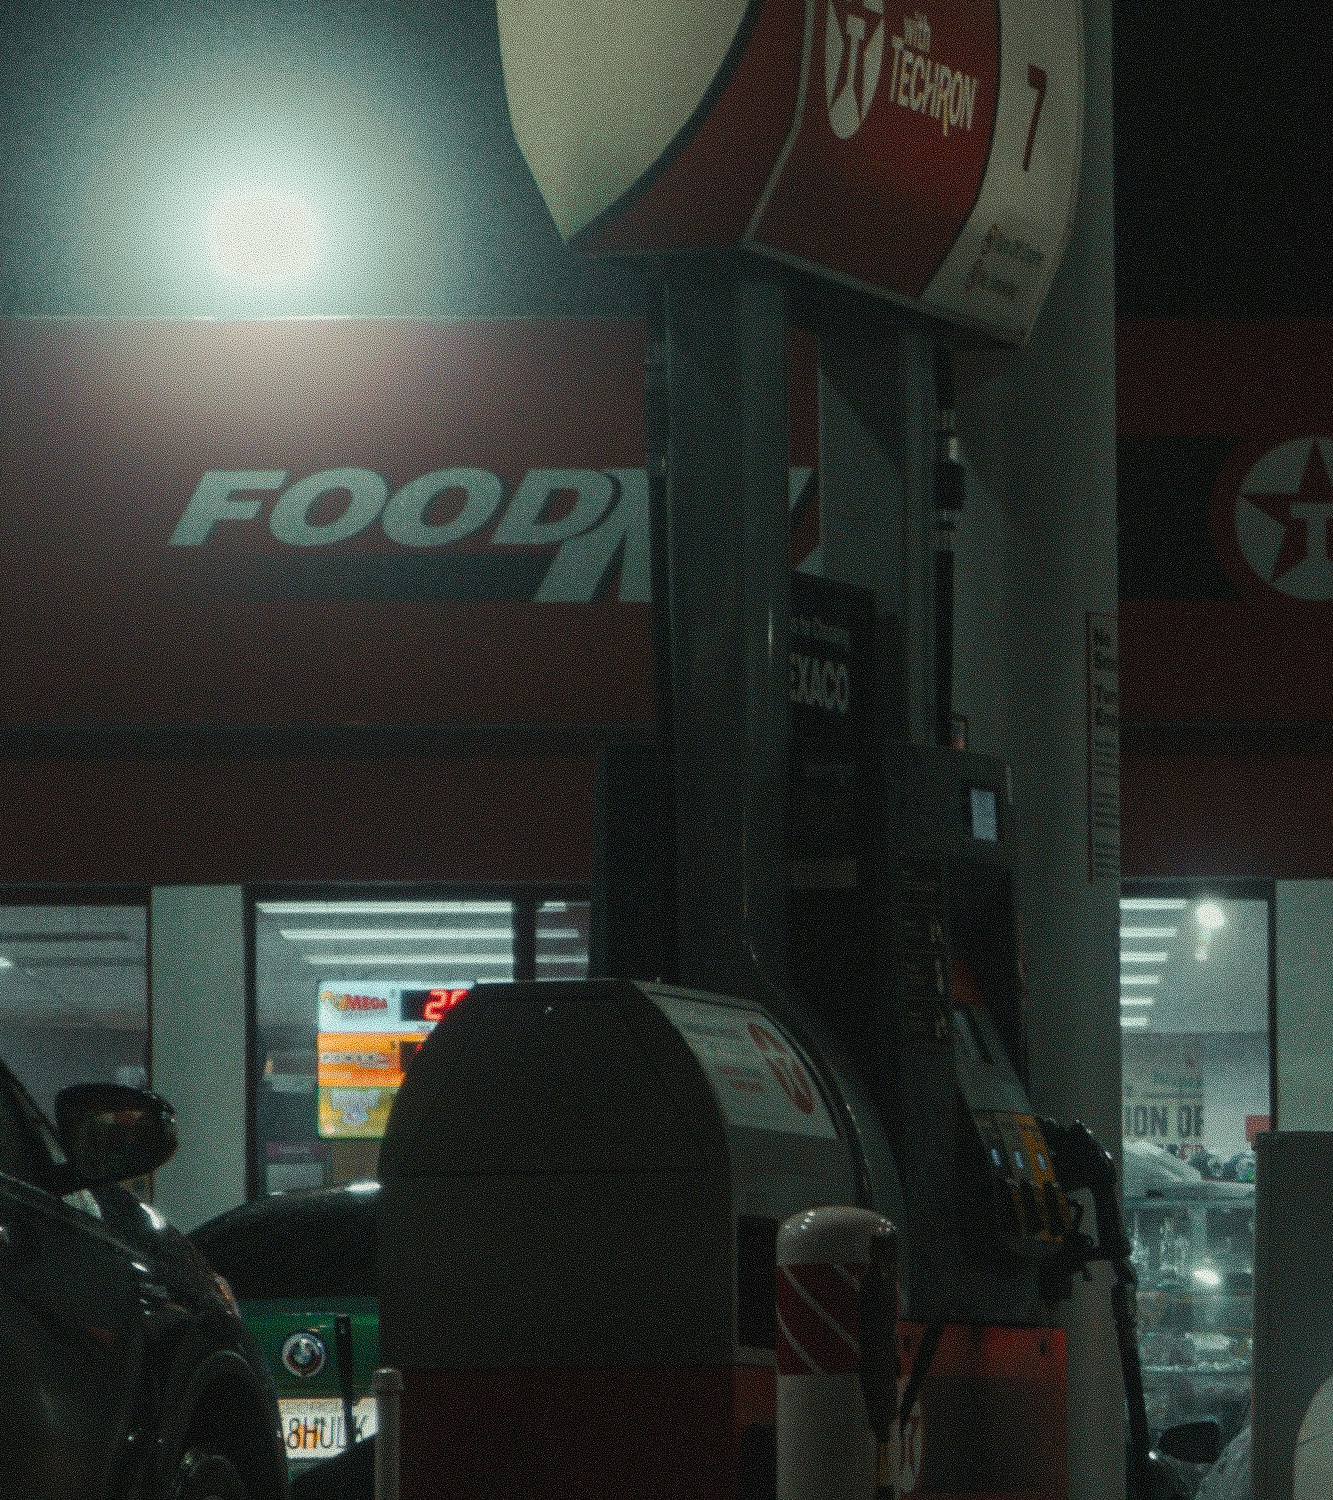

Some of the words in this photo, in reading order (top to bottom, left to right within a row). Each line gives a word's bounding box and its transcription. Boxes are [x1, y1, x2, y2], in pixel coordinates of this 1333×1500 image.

[887, 34, 979, 137] TECHRON
[1023, 65, 1047, 172] 7
[169, 466, 617, 547] FOOD
[788, 652, 851, 715] EXACO
